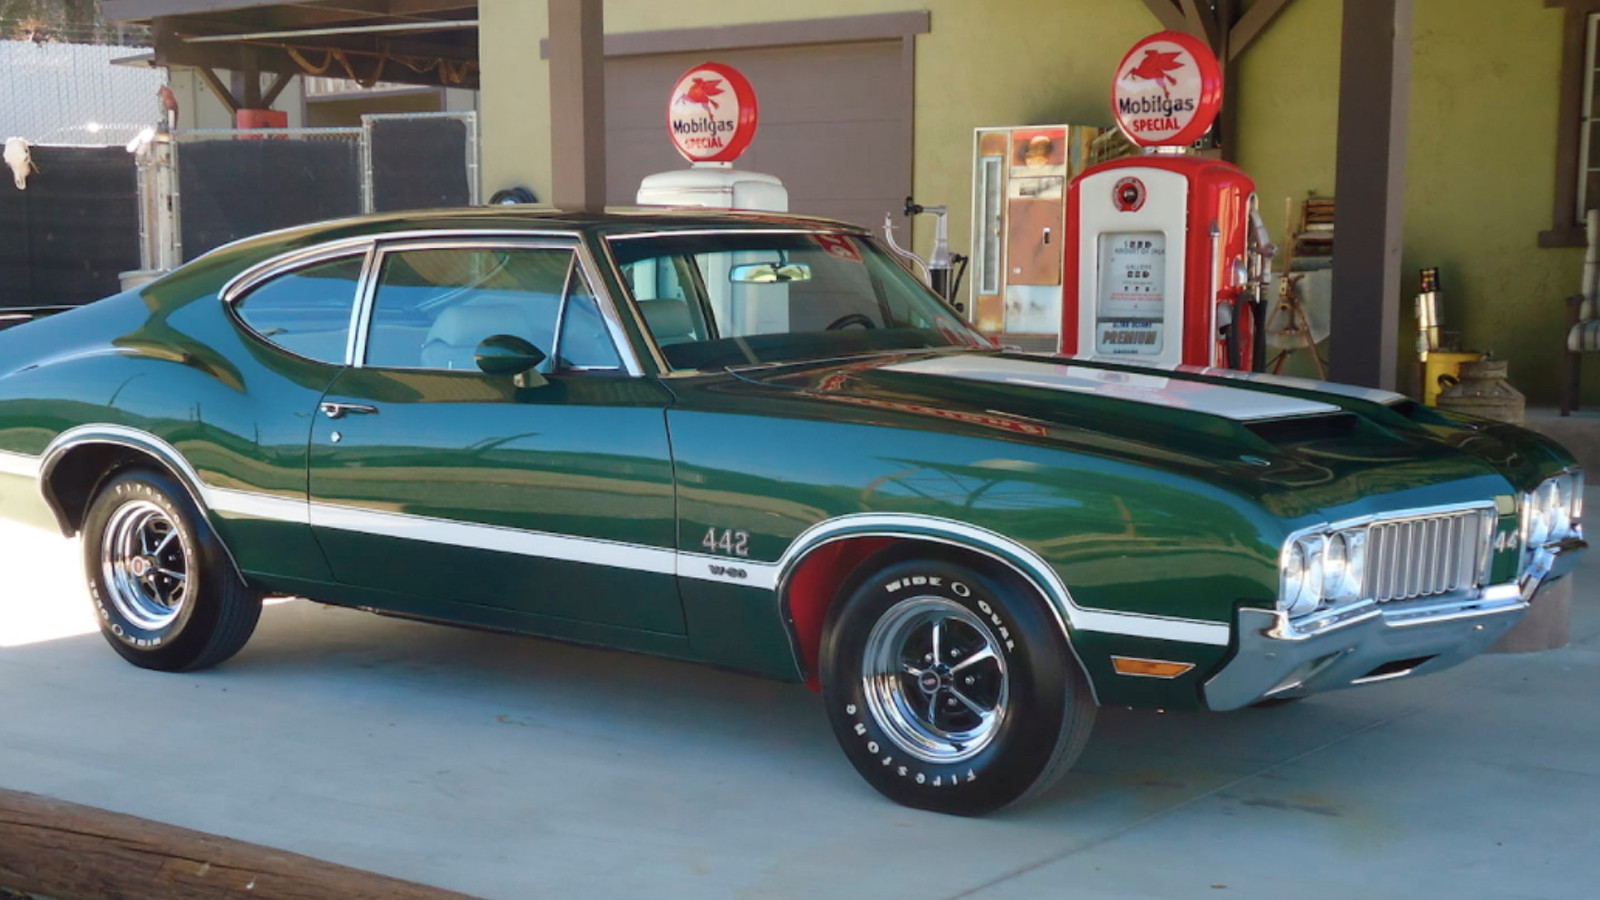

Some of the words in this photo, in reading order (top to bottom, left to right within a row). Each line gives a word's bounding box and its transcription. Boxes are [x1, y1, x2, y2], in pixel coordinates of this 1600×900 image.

[1119, 95, 1194, 117] Mobilgas
[673, 117, 734, 136] Mobilgas
[1133, 117, 1180, 132] SPECIAL
[685, 137, 724, 149] SPECIAL
[1102, 331, 1157, 345] PREMIUM
[702, 527, 749, 557] 442
[885, 576, 943, 593] WIDE
[977, 599, 1016, 653] OVAL
